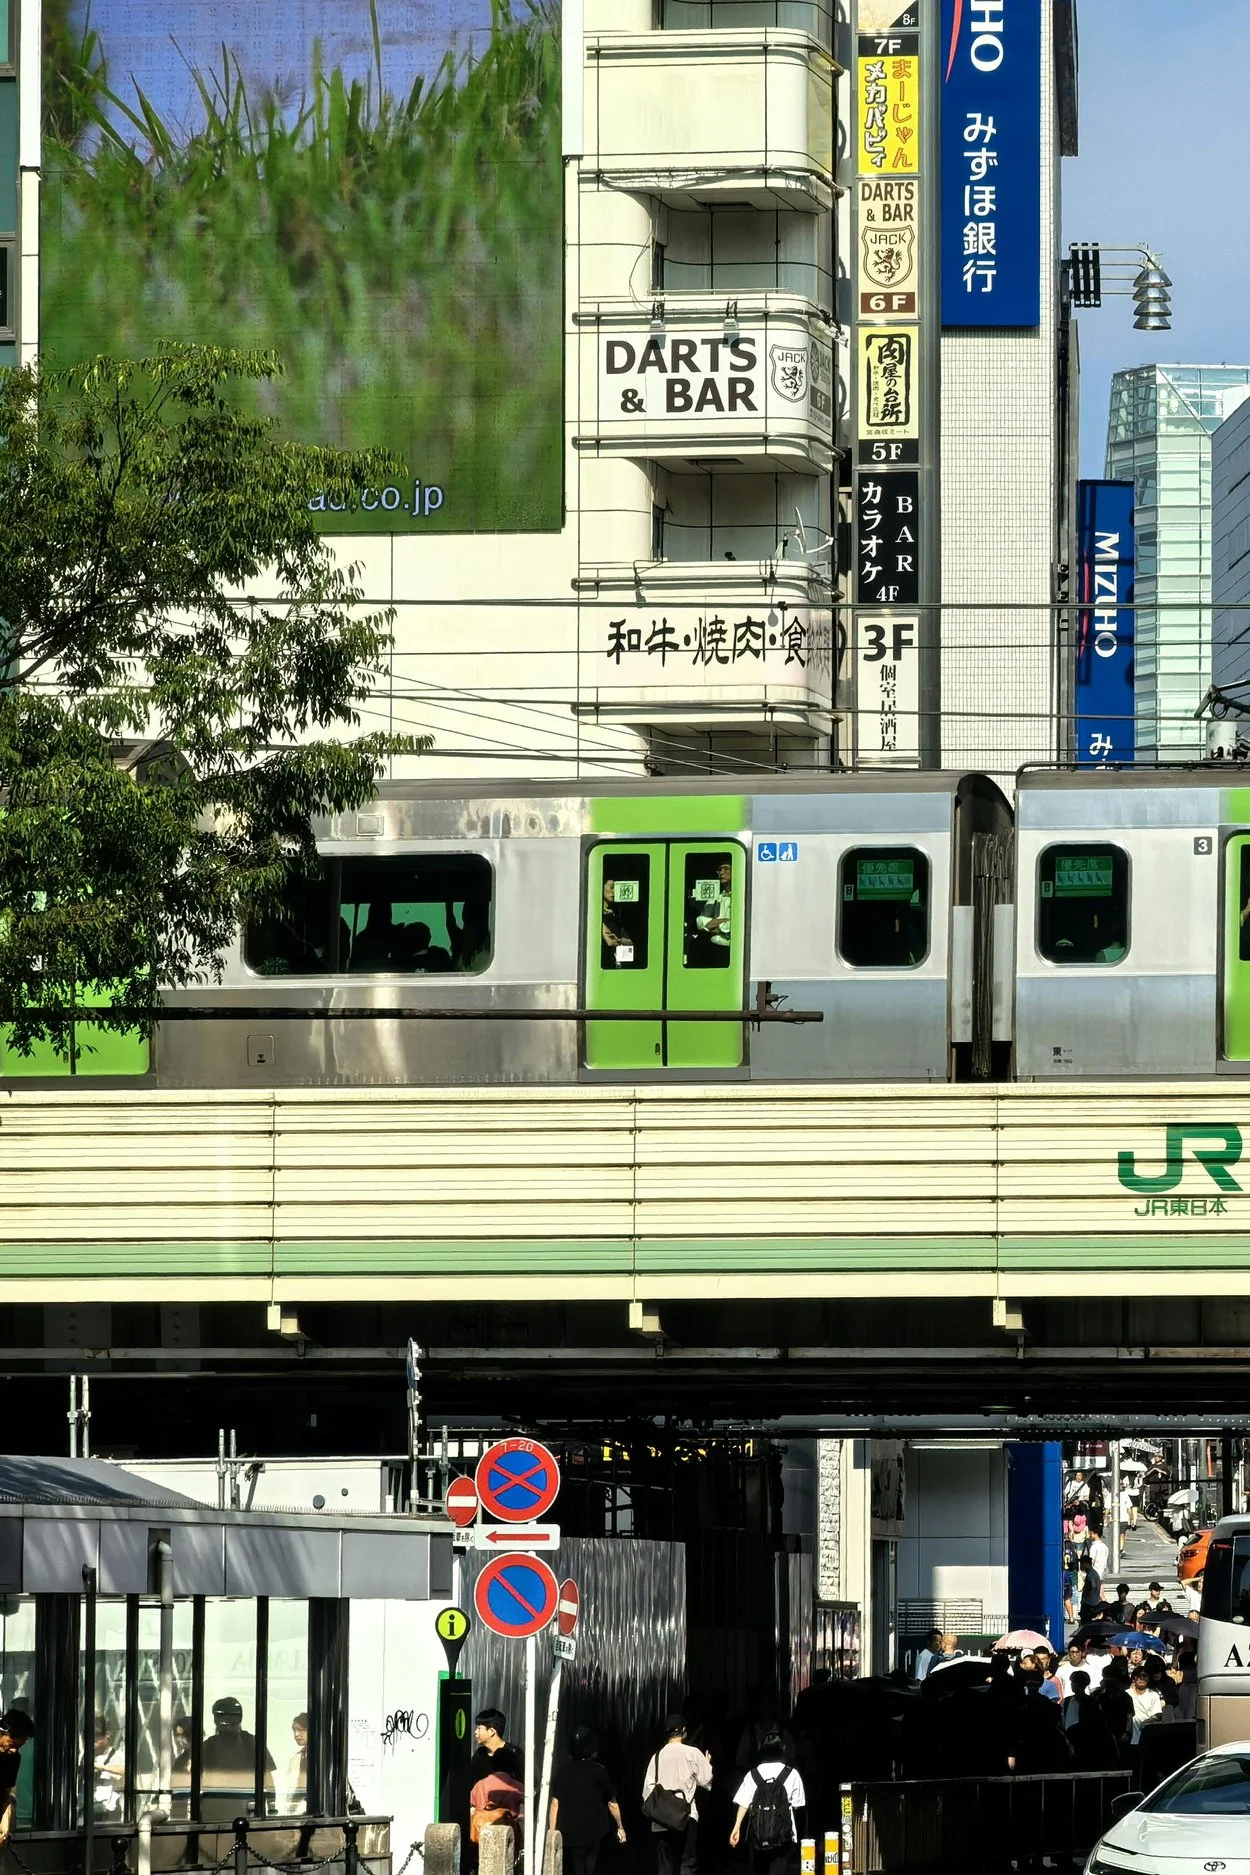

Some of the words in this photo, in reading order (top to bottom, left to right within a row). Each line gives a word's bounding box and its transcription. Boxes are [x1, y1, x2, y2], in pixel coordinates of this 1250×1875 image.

[903, 13, 916, 26] 8F
[874, 38, 902, 55] 7F
[891, 59, 913, 169] まーじゃん
[861, 181, 914, 202] DARTS
[963, 112, 998, 293] みずほ銀行
[866, 208, 876, 222] &
[882, 203, 914, 222] BAR
[870, 232, 907, 245] JACK
[605, 337, 757, 374] DARTS
[777, 351, 806, 363] JACK
[620, 388, 647, 413] &
[665, 376, 759, 413] BAR
[877, 337, 904, 422] 肉屋の台所
[871, 442, 903, 461] 5F
[860, 482, 884, 584] カラオケ
[895, 496, 915, 572] BAR
[876, 585, 900, 602] 4F
[1094, 531, 1120, 658] MIZUHO
[606, 614, 831, 673] 和牛・焼肉・食
[863, 623, 914, 662] 3F
[879, 664, 897, 752] 個室居酒屋
[1198, 838, 1209, 853] 3
[1117, 1122, 1244, 1194] JR
[1134, 1199, 1228, 1217] JR東日本
